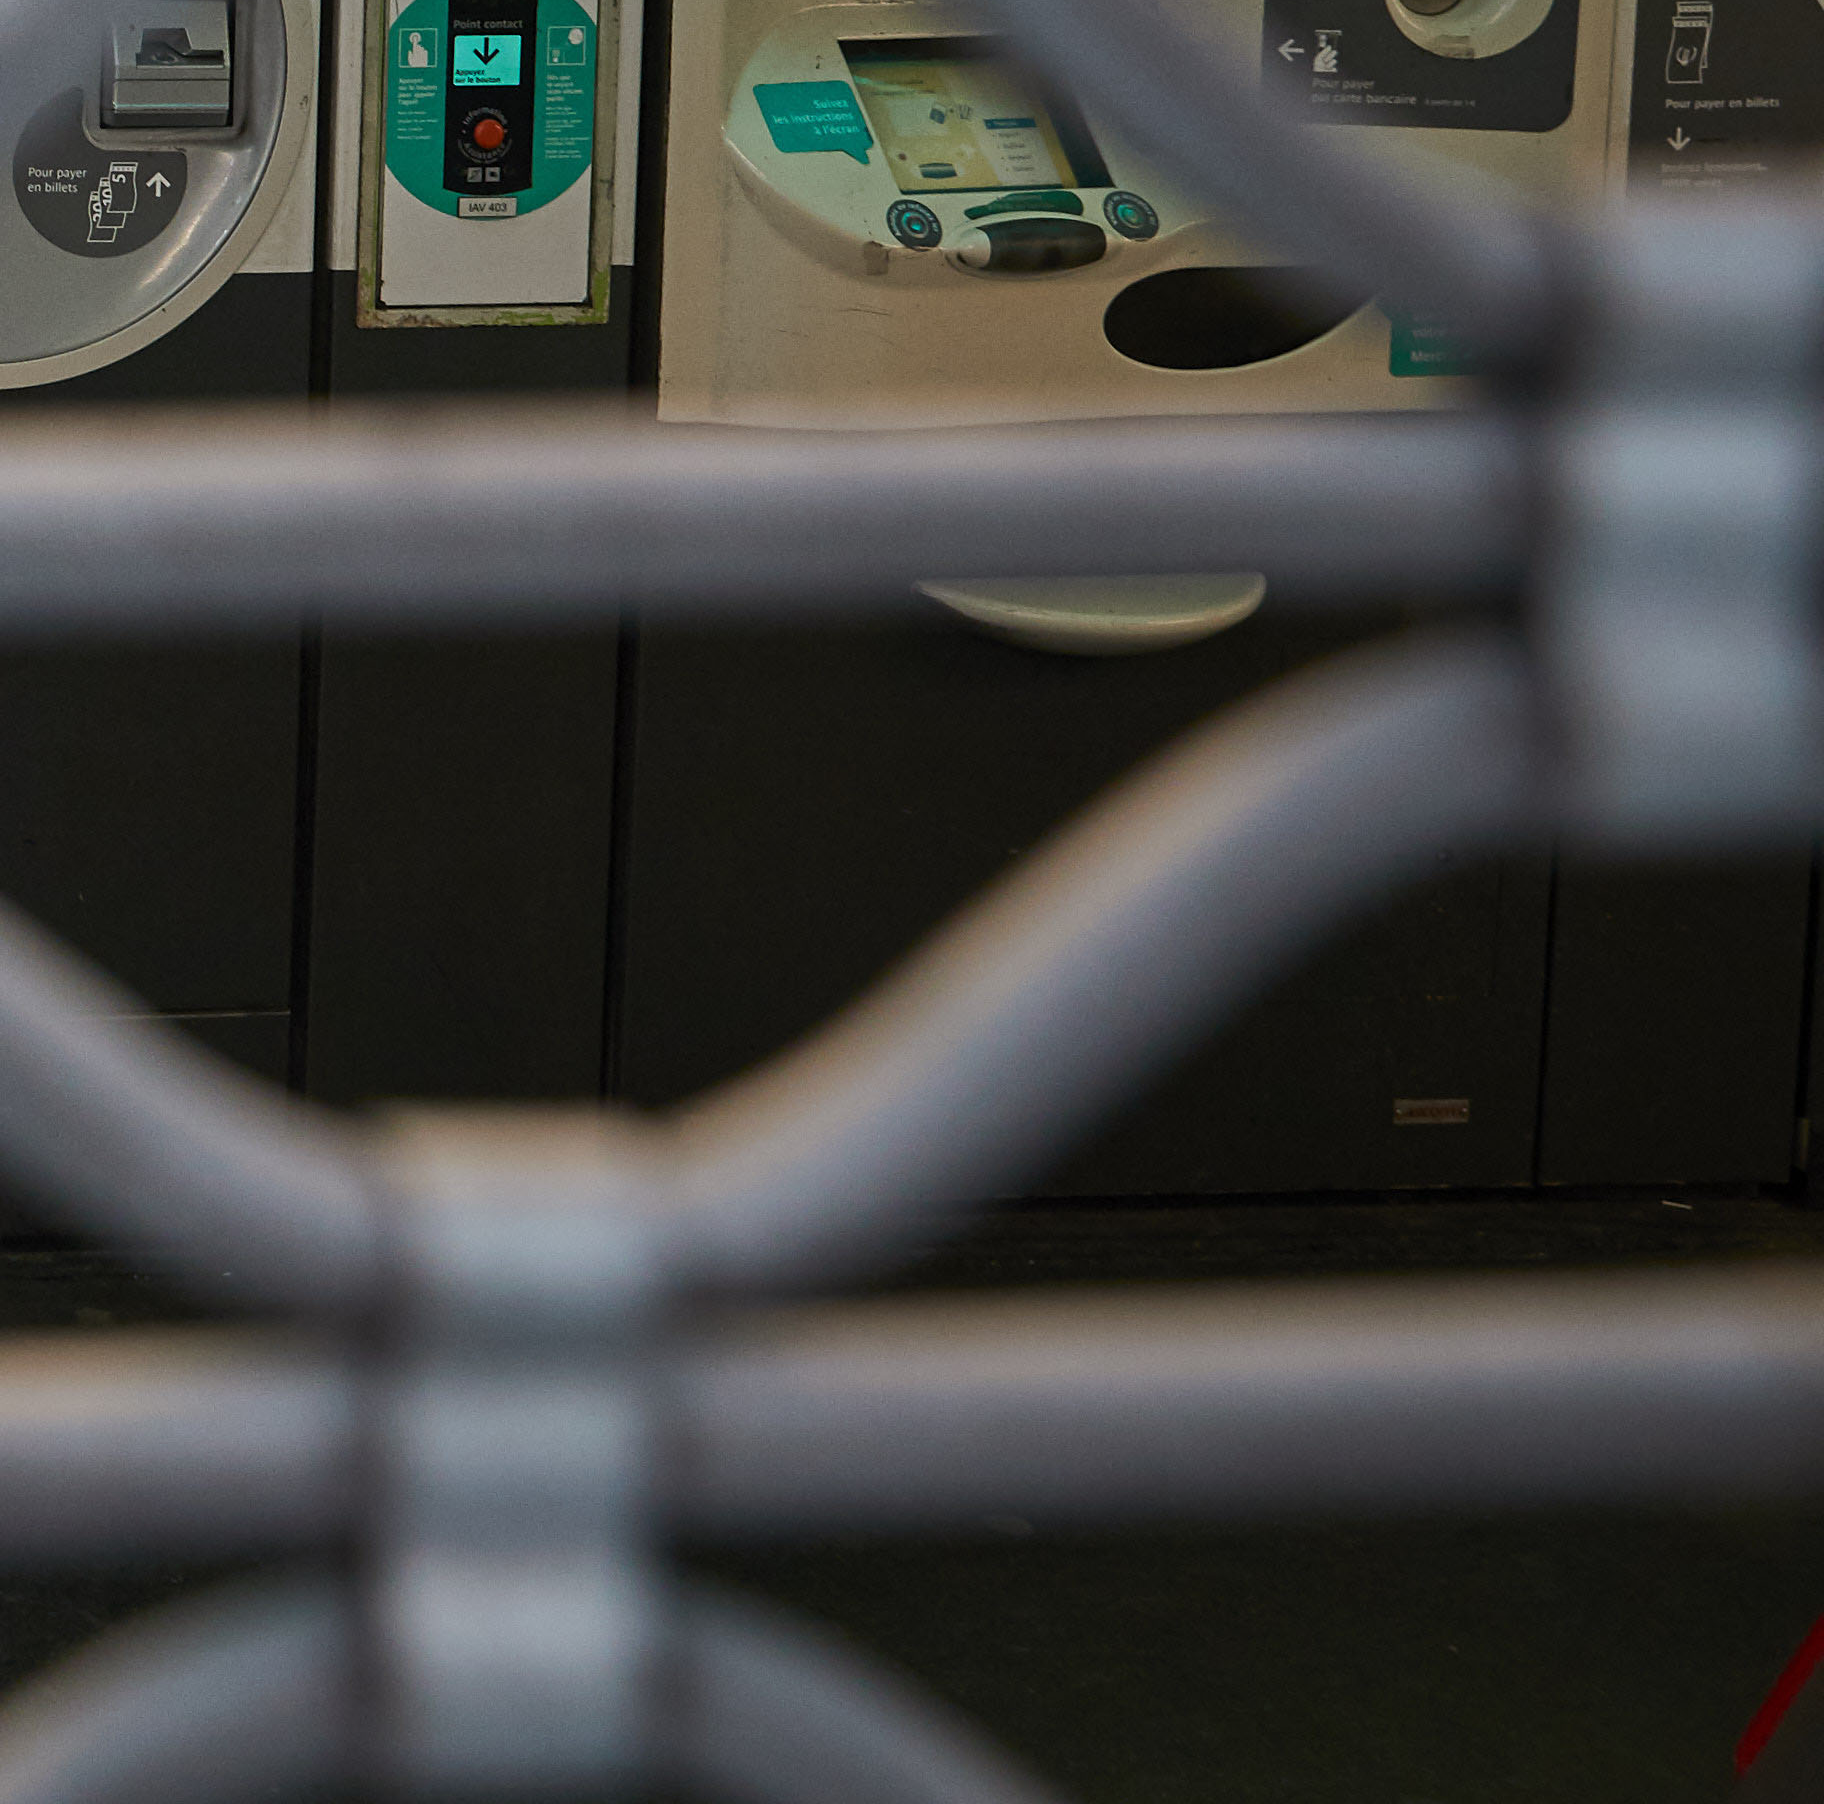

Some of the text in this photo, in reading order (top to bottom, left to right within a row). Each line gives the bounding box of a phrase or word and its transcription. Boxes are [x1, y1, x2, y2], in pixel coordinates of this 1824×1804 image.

[453, 20, 523, 29] Point contact
[1665, 97, 1781, 110] Pour payer en billets
[28, 167, 88, 181] Pour payer
[27, 182, 79, 193] en billets
